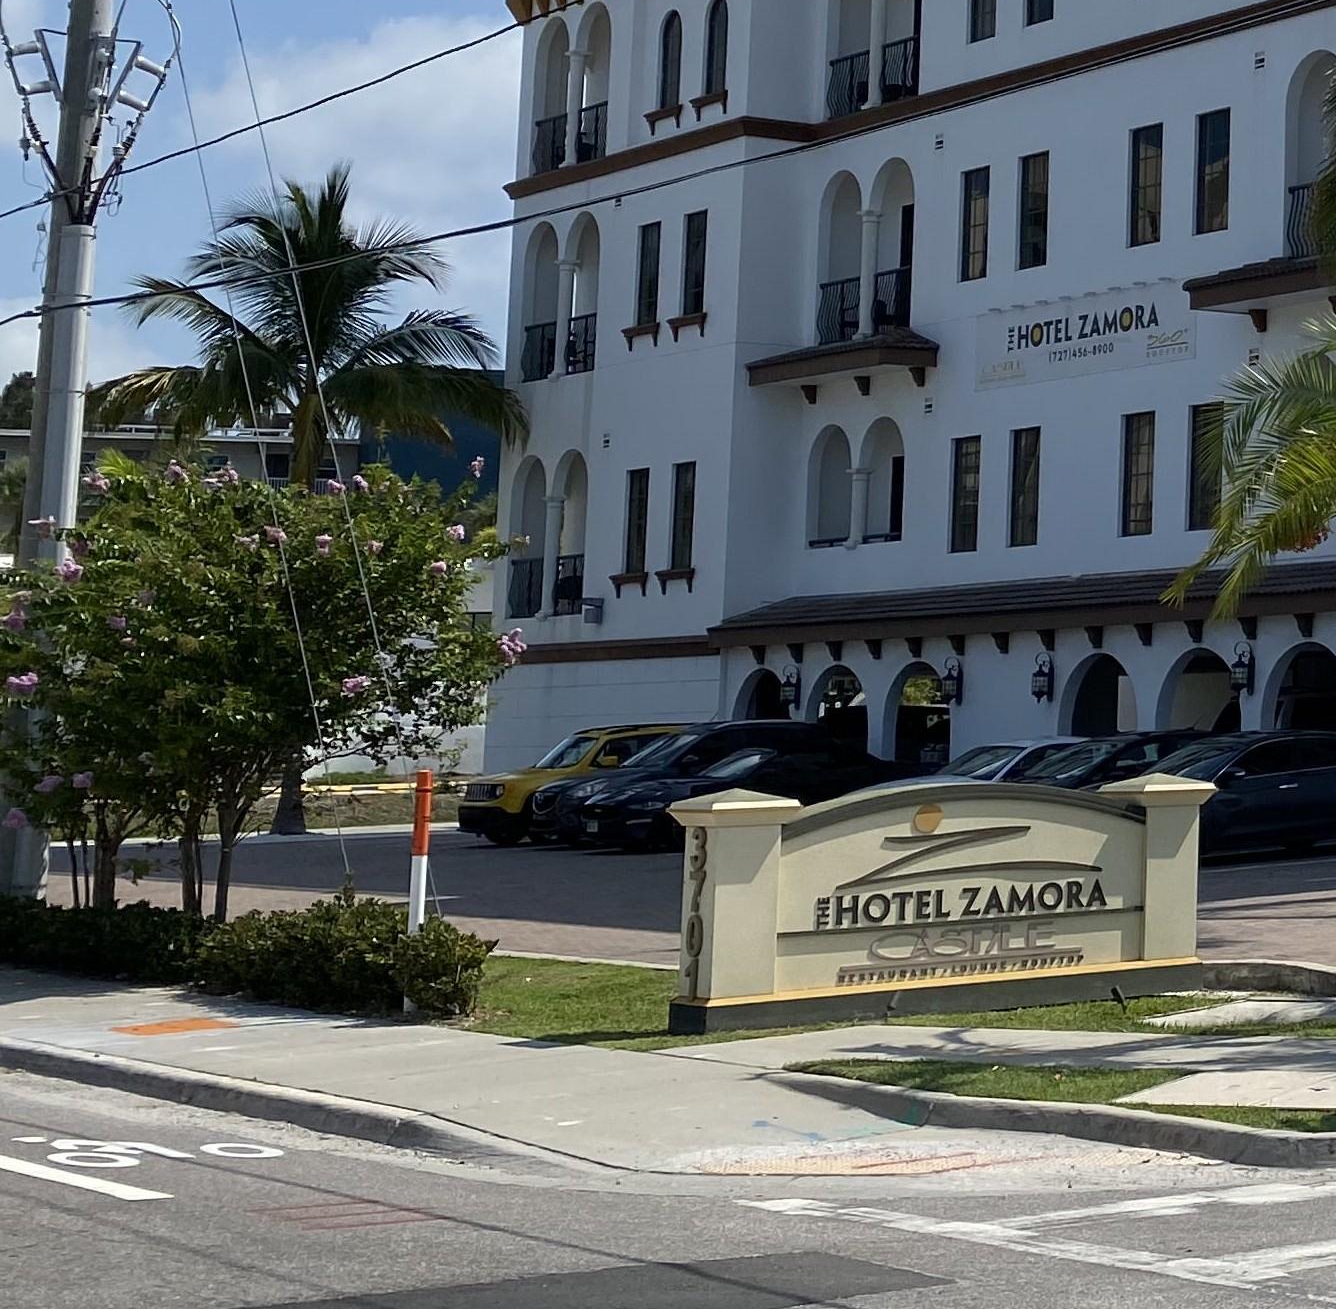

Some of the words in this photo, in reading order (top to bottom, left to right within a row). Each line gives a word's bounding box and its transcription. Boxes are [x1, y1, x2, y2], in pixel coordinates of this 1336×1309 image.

[1017, 317, 1072, 349] HOTEL
[1078, 302, 1159, 339] ZAMORA
[684, 826, 707, 1002] 3701
[817, 896, 830, 928] THE
[836, 889, 950, 927] HOTEL
[960, 879, 1107, 917] ZAMORA
